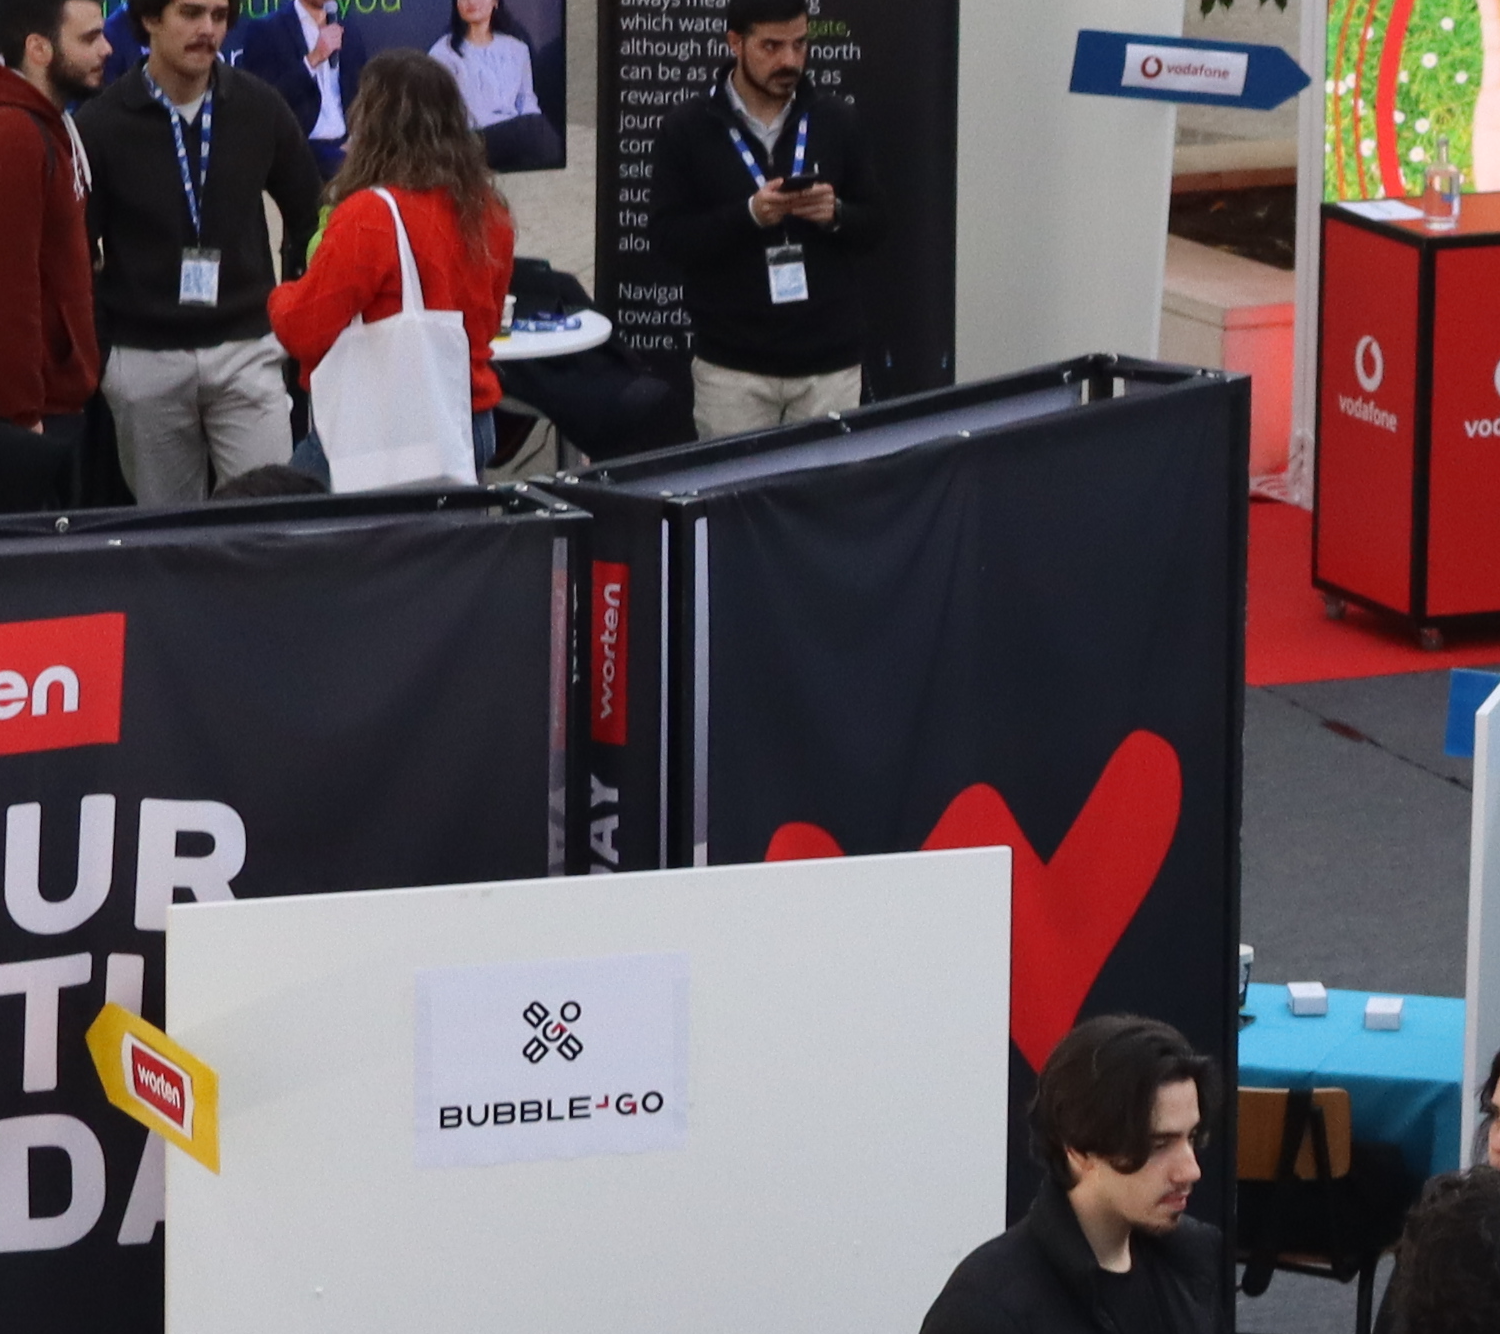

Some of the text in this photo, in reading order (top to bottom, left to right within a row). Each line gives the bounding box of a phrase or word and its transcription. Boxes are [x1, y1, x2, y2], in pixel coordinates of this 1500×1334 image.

[620, 13, 674, 33] which
[620, 38, 701, 62] although
[810, 42, 862, 60] north
[620, 66, 653, 81] can
[657, 63, 680, 81] be
[686, 66, 707, 81] as
[821, 69, 842, 85] as
[1166, 63, 1230, 79] vodafone
[618, 308, 692, 325] towards
[1339, 395, 1399, 433] vodafone
[599, 581, 622, 720] worten
[136, 1062, 182, 1111] worten
